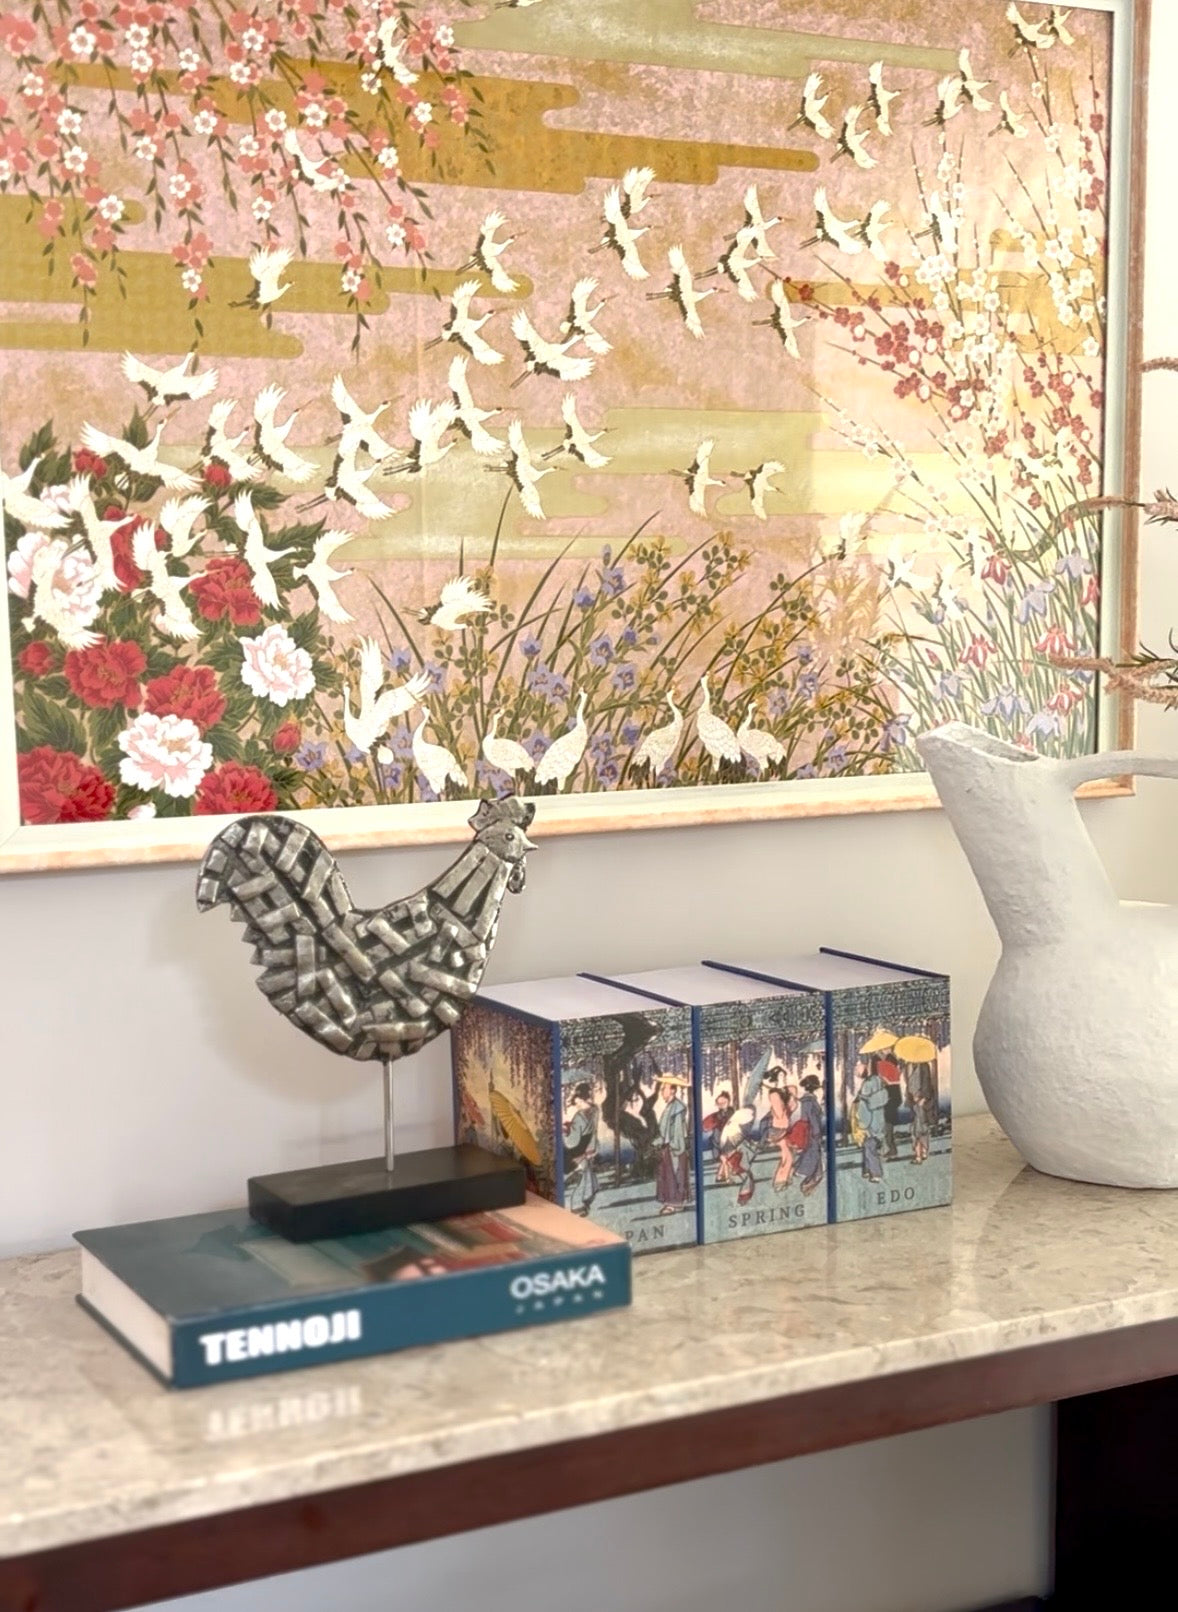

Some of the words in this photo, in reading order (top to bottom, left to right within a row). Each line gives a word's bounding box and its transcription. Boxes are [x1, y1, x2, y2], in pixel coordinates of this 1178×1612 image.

[877, 1187, 915, 1205] EDO
[728, 1204, 806, 1230] SPRING
[624, 1225, 665, 1243] PAN
[510, 1263, 606, 1299] OSAKA
[199, 1309, 362, 1366] TENNOJI
